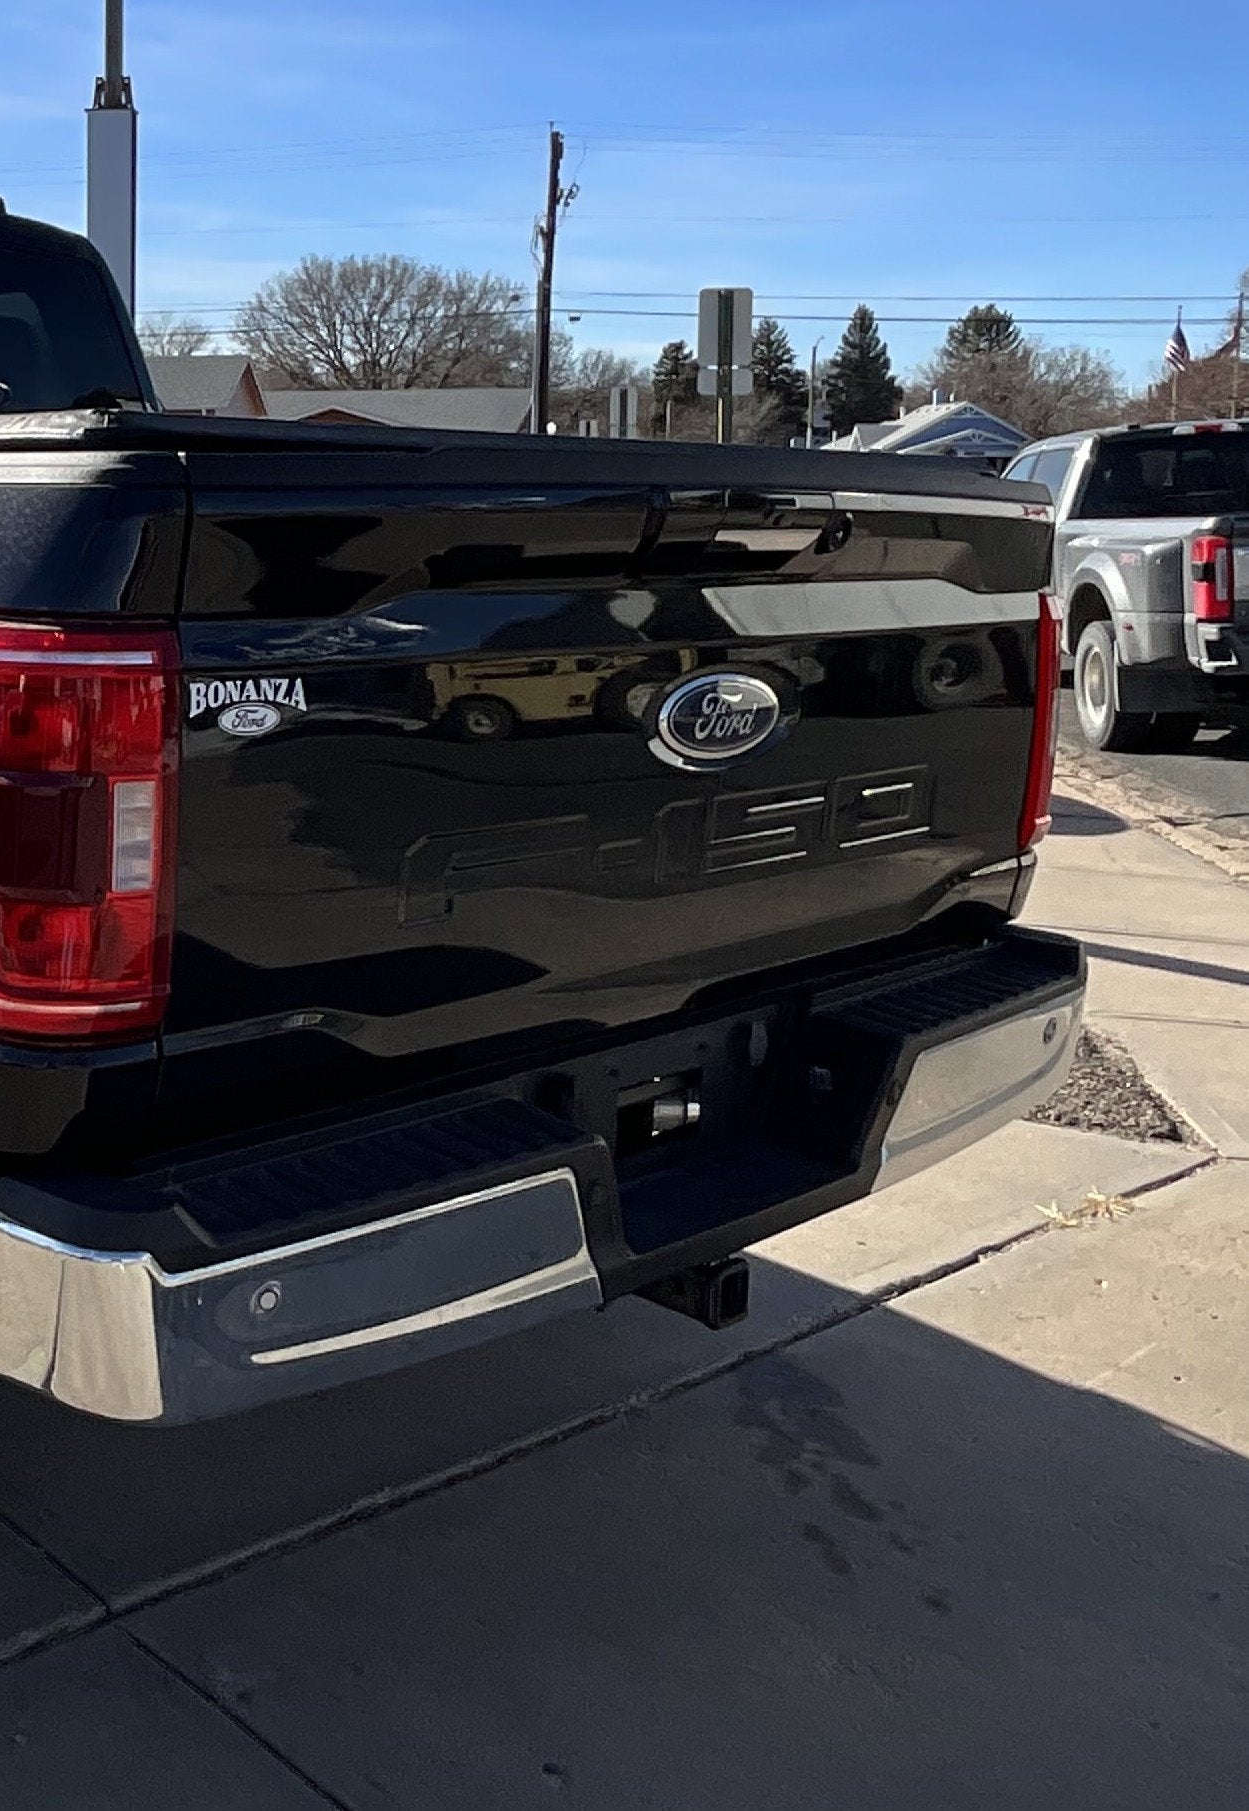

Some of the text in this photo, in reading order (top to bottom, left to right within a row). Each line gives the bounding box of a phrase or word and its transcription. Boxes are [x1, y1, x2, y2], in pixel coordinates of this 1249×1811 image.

[189, 677, 307, 718] BONANZA
[231, 709, 268, 730] Ford
[694, 692, 759, 741] Ford
[397, 764, 932, 928] F-150
